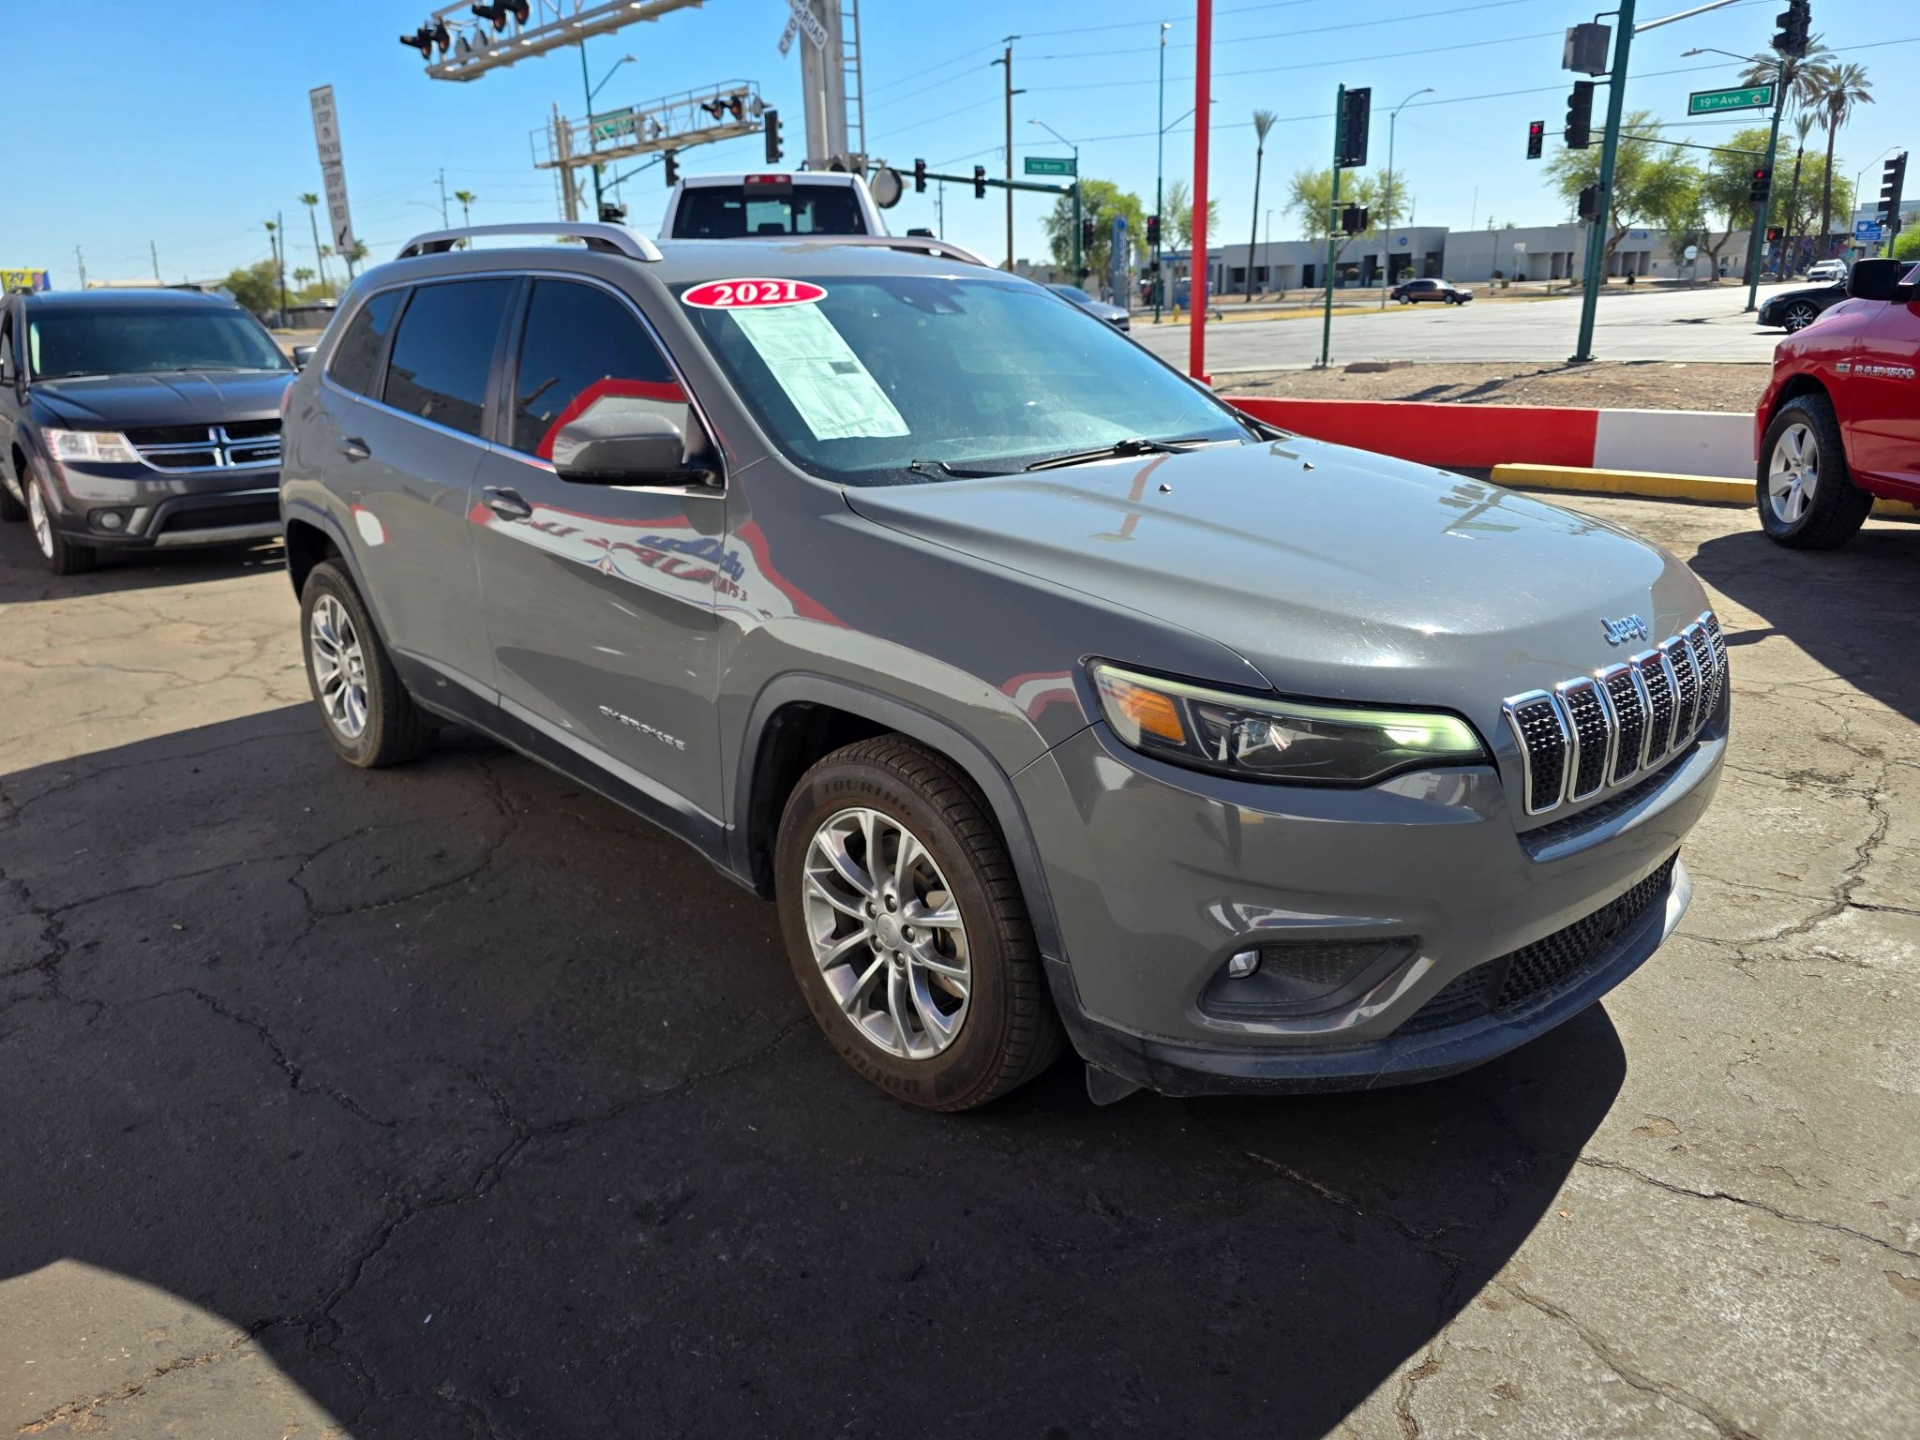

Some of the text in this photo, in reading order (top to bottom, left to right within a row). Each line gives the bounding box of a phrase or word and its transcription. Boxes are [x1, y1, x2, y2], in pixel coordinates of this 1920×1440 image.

[713, 282, 800, 306] 2021
[1854, 364, 1885, 376] RAM
[1600, 614, 1648, 646] Jeep
[598, 705, 687, 750] CHEROKEE
